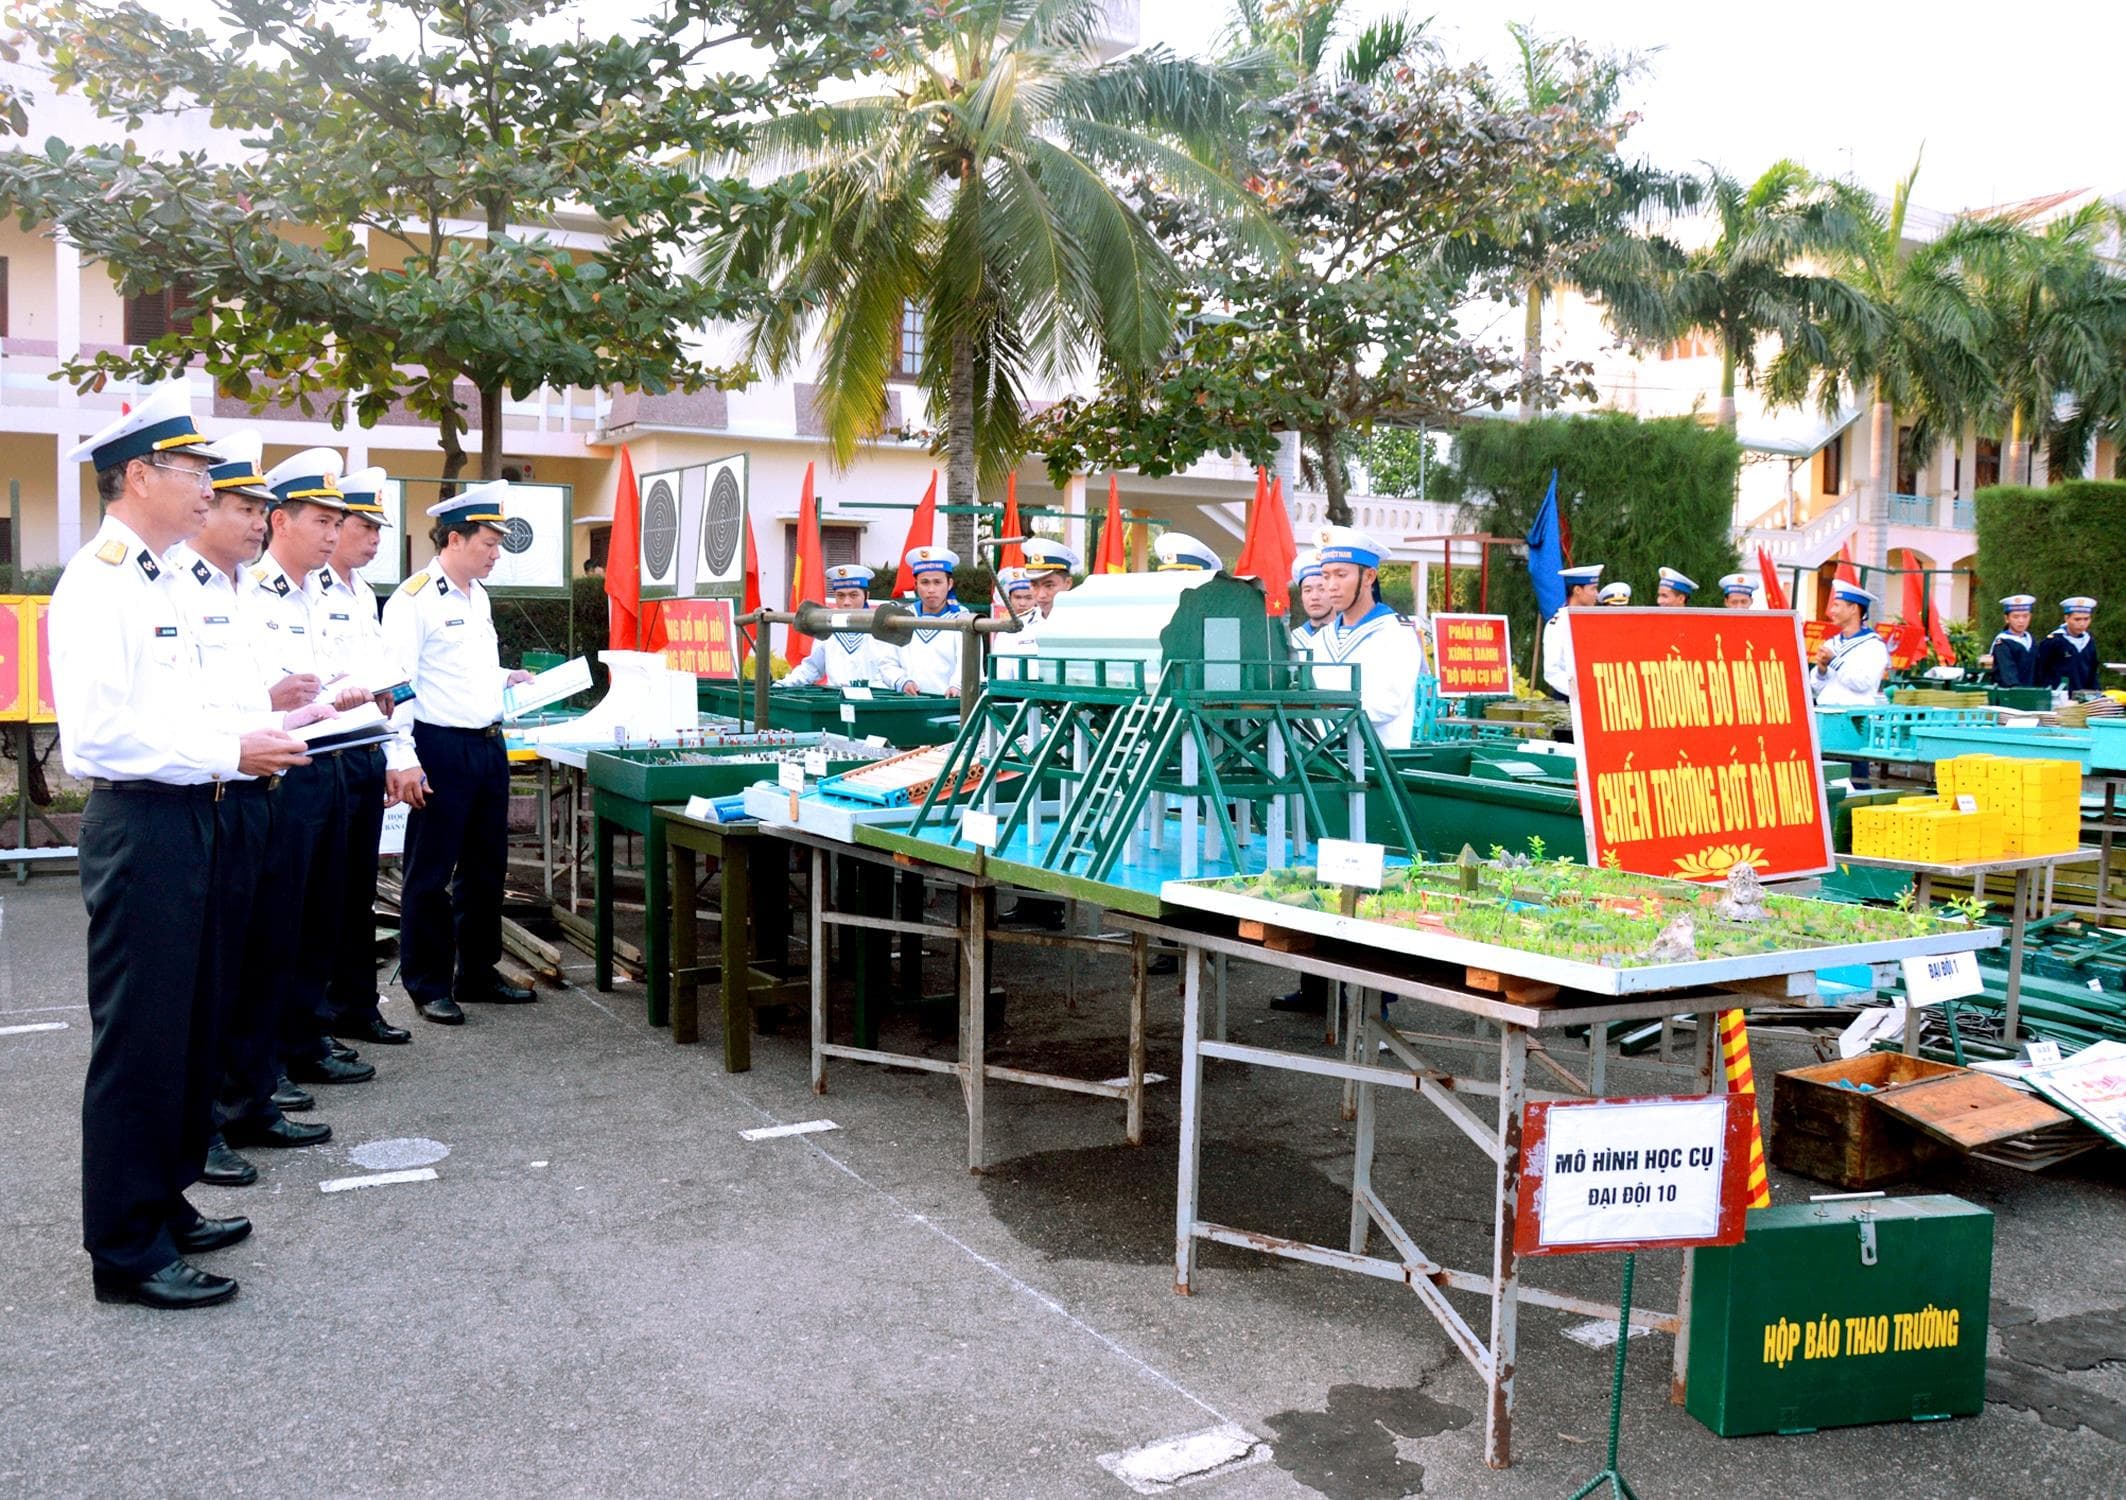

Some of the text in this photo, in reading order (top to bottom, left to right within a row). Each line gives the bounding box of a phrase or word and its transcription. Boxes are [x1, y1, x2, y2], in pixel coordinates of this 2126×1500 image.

[1448, 620, 1494, 641] PHẤN ĐẤU
[1447, 643, 1499, 662] XỨNG DANH
[1460, 666, 1477, 686] ĐỘI
[1477, 668, 1490, 686] CỤ
[1592, 633, 1791, 732] THAO TRƯỜNG ĐỔ MỒ HÔI
[1597, 735, 1814, 845] CHIẾN TRƯỜNG BỚT ĐỔ MÁU
[1928, 961, 1941, 982] ĐẠI
[1953, 959, 1959, 974] 1
[1555, 1147, 1714, 1174] MÔ HÌNH HỌC CỤ
[1588, 1181, 1677, 1209] ĐẠI ĐỘI 10
[1763, 1303, 1959, 1369] HỘP BÁO THAO TRƯỜNG
